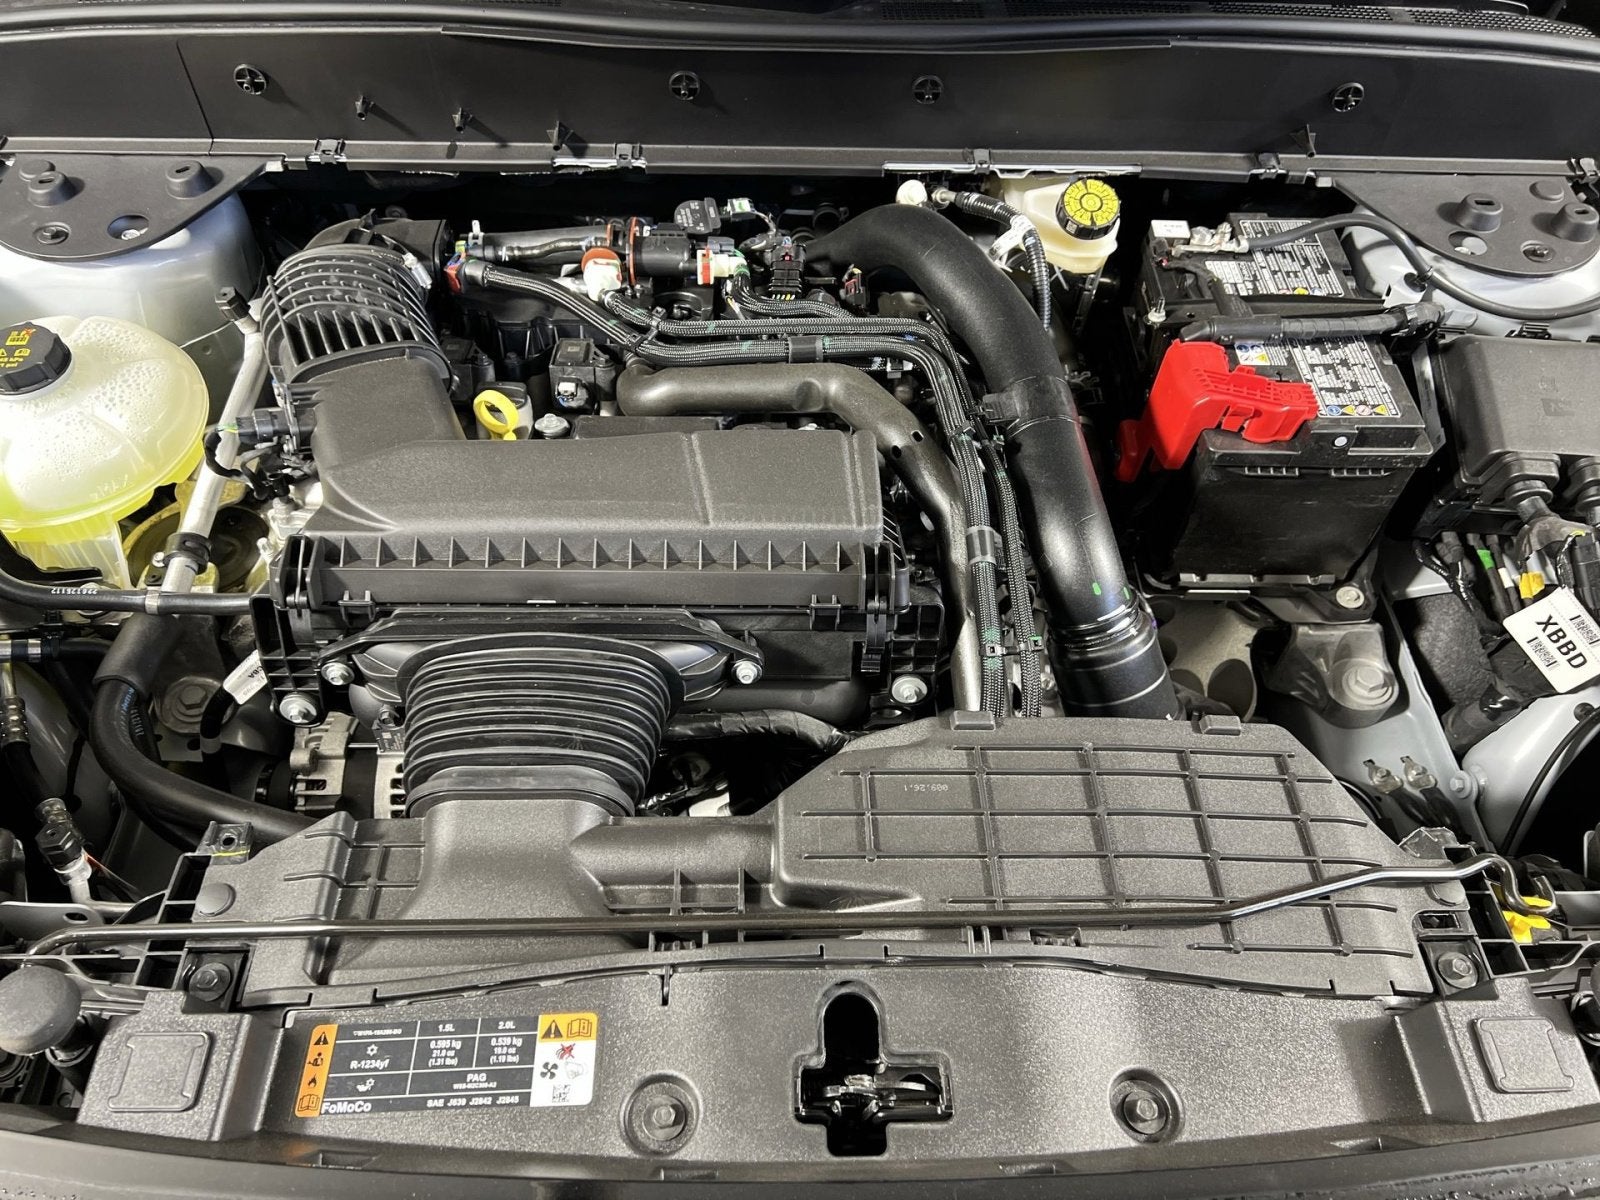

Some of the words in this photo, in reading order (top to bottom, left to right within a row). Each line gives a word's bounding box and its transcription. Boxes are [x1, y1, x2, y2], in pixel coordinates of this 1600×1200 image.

[1535, 614, 1588, 669] XBBD
[438, 1024, 456, 1033] 1.5L
[498, 1021, 516, 1030] 2.0L
[451, 1039, 462, 1050] kg
[512, 1036, 523, 1047] kg
[350, 1058, 390, 1070] R-1234yf
[466, 1073, 487, 1082] PAG
[320, 1101, 372, 1114] FoMoCo
[426, 1099, 445, 1107] SAE
